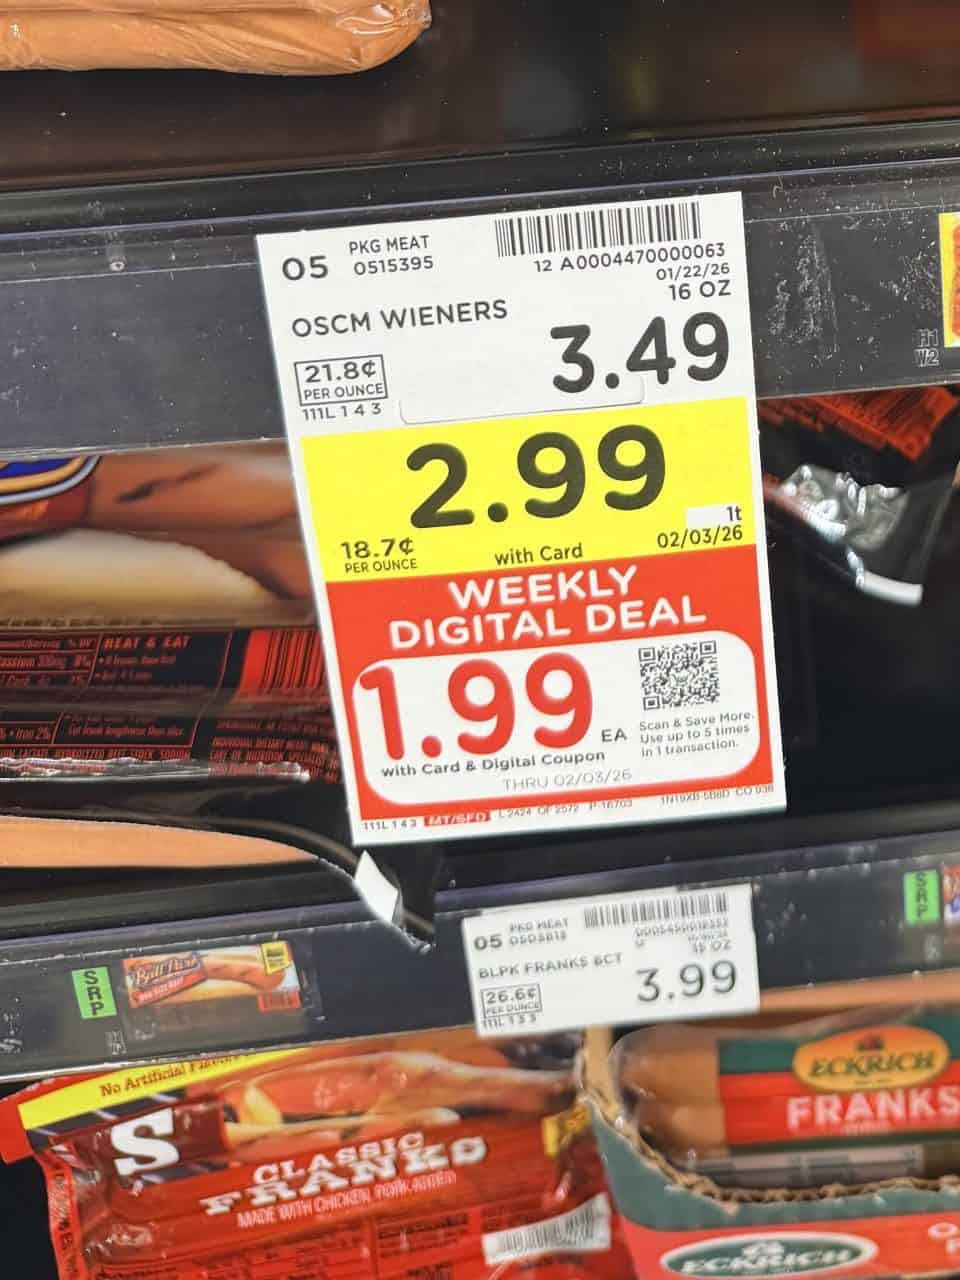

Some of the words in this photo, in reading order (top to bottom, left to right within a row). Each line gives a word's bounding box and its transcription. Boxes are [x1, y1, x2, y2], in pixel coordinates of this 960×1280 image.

[349, 239, 381, 255] PKG
[386, 235, 430, 252] MEAT
[282, 255, 329, 281] 05
[353, 255, 434, 276] 0515395
[534, 260, 553, 273] 12
[560, 242, 725, 271] A0004470000063
[656, 262, 730, 281] 01/22/26
[668, 283, 691, 301] 16
[699, 280, 731, 298] OZ
[291, 311, 371, 338] OSCM
[380, 299, 508, 330] WIENERS
[550, 311, 729, 394] 3.49
[305, 359, 377, 384] 21.8¢
[304, 388, 331, 401] PER
[334, 383, 384, 398] OUNCE
[302, 406, 335, 421] 111L
[341, 405, 347, 418] 1
[354, 404, 365, 416] 4
[372, 403, 382, 415] 3
[405, 424, 666, 530] 2.99
[726, 506, 742, 522] 1t
[341, 537, 414, 560] 18.7¢
[657, 525, 743, 549] 02/03/26
[344, 560, 370, 574] PER
[372, 558, 418, 573] OUNCE
[494, 548, 534, 567] with
[540, 543, 583, 561] Card
[449, 566, 637, 610] WEEKLY
[389, 608, 571, 650] DIGITAL
[587, 596, 706, 634] DEAL
[163, 636, 191, 648] EAT
[358, 652, 593, 761] 1.99
[639, 721, 670, 731] Scan
[673, 719, 682, 728] &
[685, 716, 716, 727] Save
[720, 711, 755, 722] More.
[601, 728, 628, 743] EA
[640, 734, 663, 744] Use
[667, 731, 684, 743] up
[687, 729, 701, 739] to
[704, 727, 712, 738] 5
[716, 724, 750, 735] times
[641, 747, 653, 758] in
[656, 745, 661, 756] 1
[665, 739, 739, 755] transaction.
[381, 763, 417, 778] with
[422, 761, 460, 775] Card
[466, 759, 476, 771] &
[482, 755, 536, 773] Digital
[541, 751, 606, 770] Coupon
[503, 775, 548, 793] THRU
[554, 769, 632, 787] 02/03/26
[474, 933, 503, 950] 05
[479, 963, 519, 979] BLPK
[524, 957, 588, 974] FRANKS
[84, 970, 104, 1016] SRP
[636, 959, 737, 1003] 3.99
[808, 1050, 936, 1077] ECKRICH
[100, 1082, 122, 1097] No
[124, 1061, 187, 1091] Artificial
[110, 1107, 180, 1177] S
[253, 1131, 425, 1185] CLASSIC
[200, 1136, 489, 1216] FRANKS
[237, 1207, 277, 1228] MADE
[280, 1200, 312, 1221] WITH
[682, 1247, 856, 1275] ECKRICH
